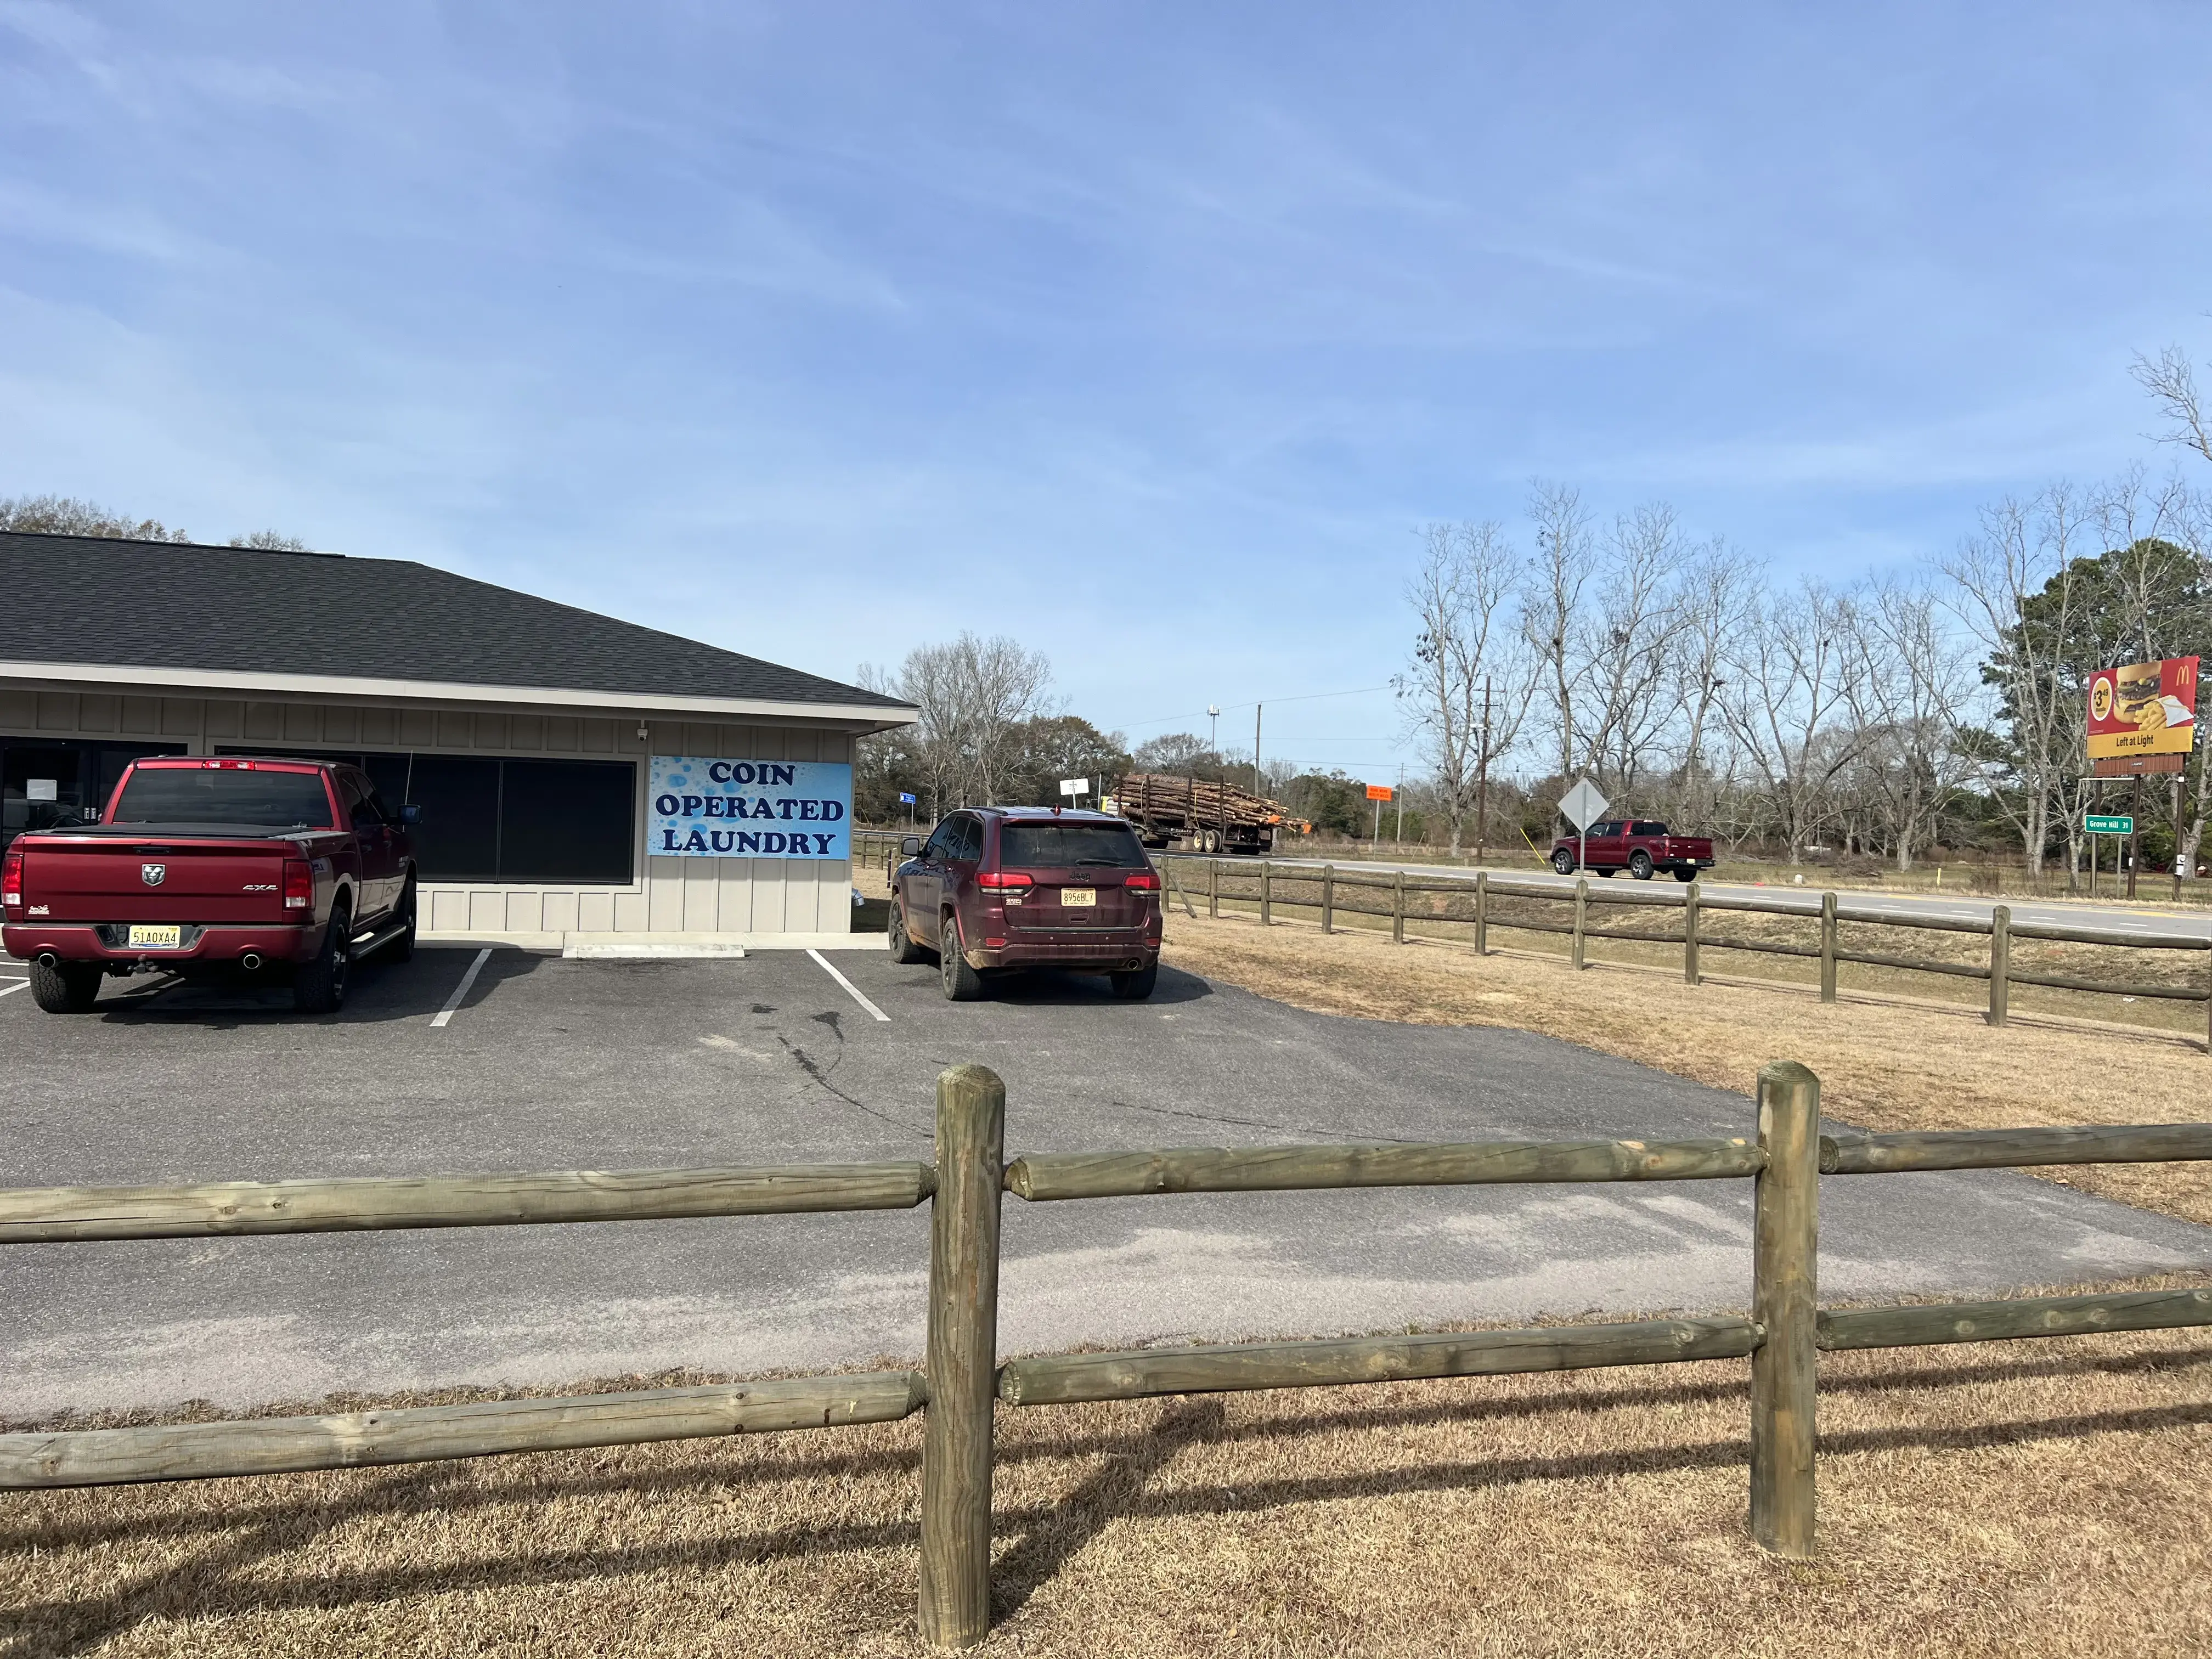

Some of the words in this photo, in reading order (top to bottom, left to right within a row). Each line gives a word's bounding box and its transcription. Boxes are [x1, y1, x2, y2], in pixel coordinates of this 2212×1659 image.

[2117, 737, 2128, 747] Left
[2130, 737, 2136, 746] at
[2137, 735, 2153, 747] Light
[709, 761, 795, 786] COIN
[656, 794, 844, 821] OPERATED
[662, 830, 836, 854] LAUNDRY
[1069, 871, 1091, 882] Jeep
[1064, 893, 1093, 901] 8956BL7
